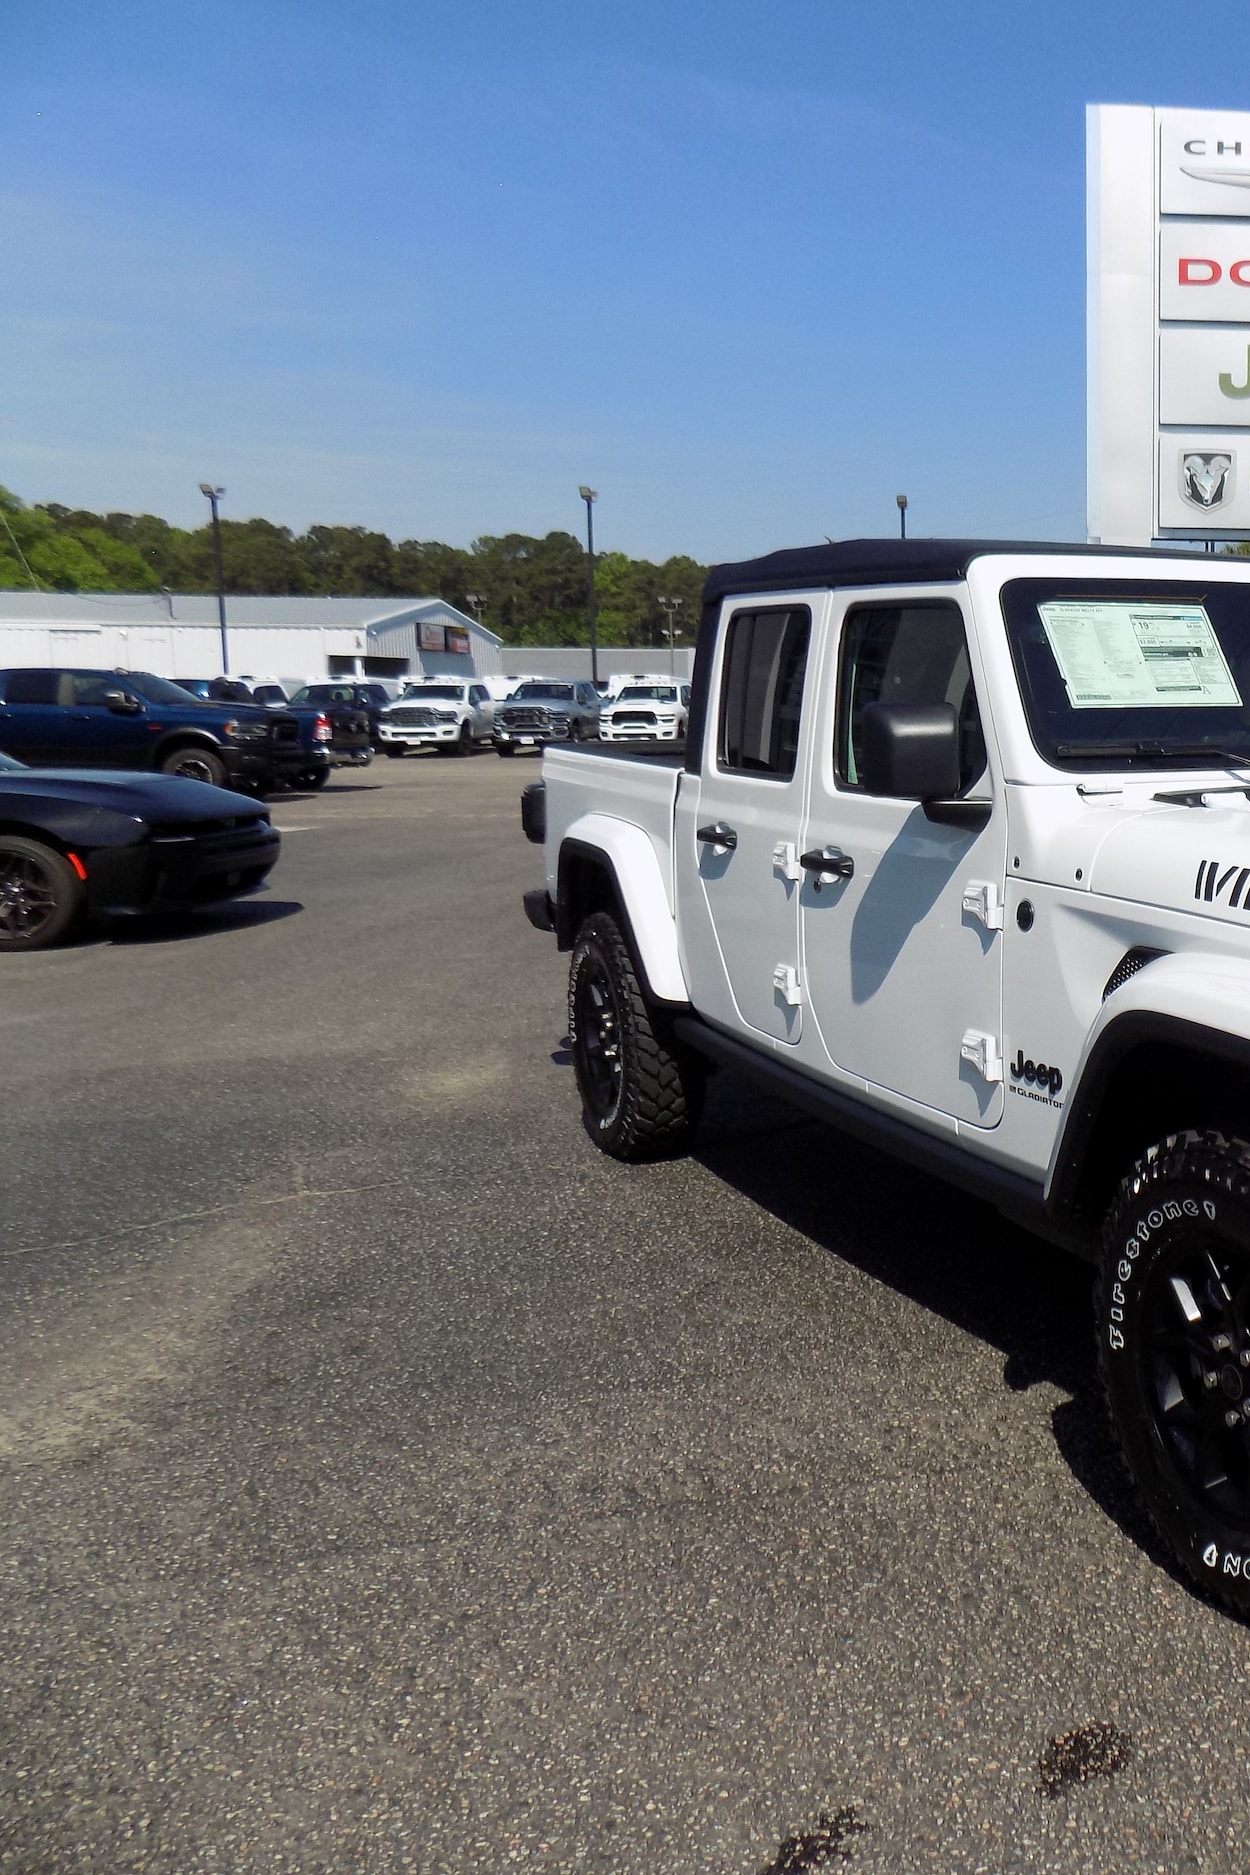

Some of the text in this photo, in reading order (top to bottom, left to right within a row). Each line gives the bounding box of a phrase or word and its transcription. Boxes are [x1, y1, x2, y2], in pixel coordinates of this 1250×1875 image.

[1010, 1049, 1063, 1096] Jeep
[1017, 1087, 1064, 1109] GLADIATOR
[1109, 1199, 1200, 1350] Firestone
